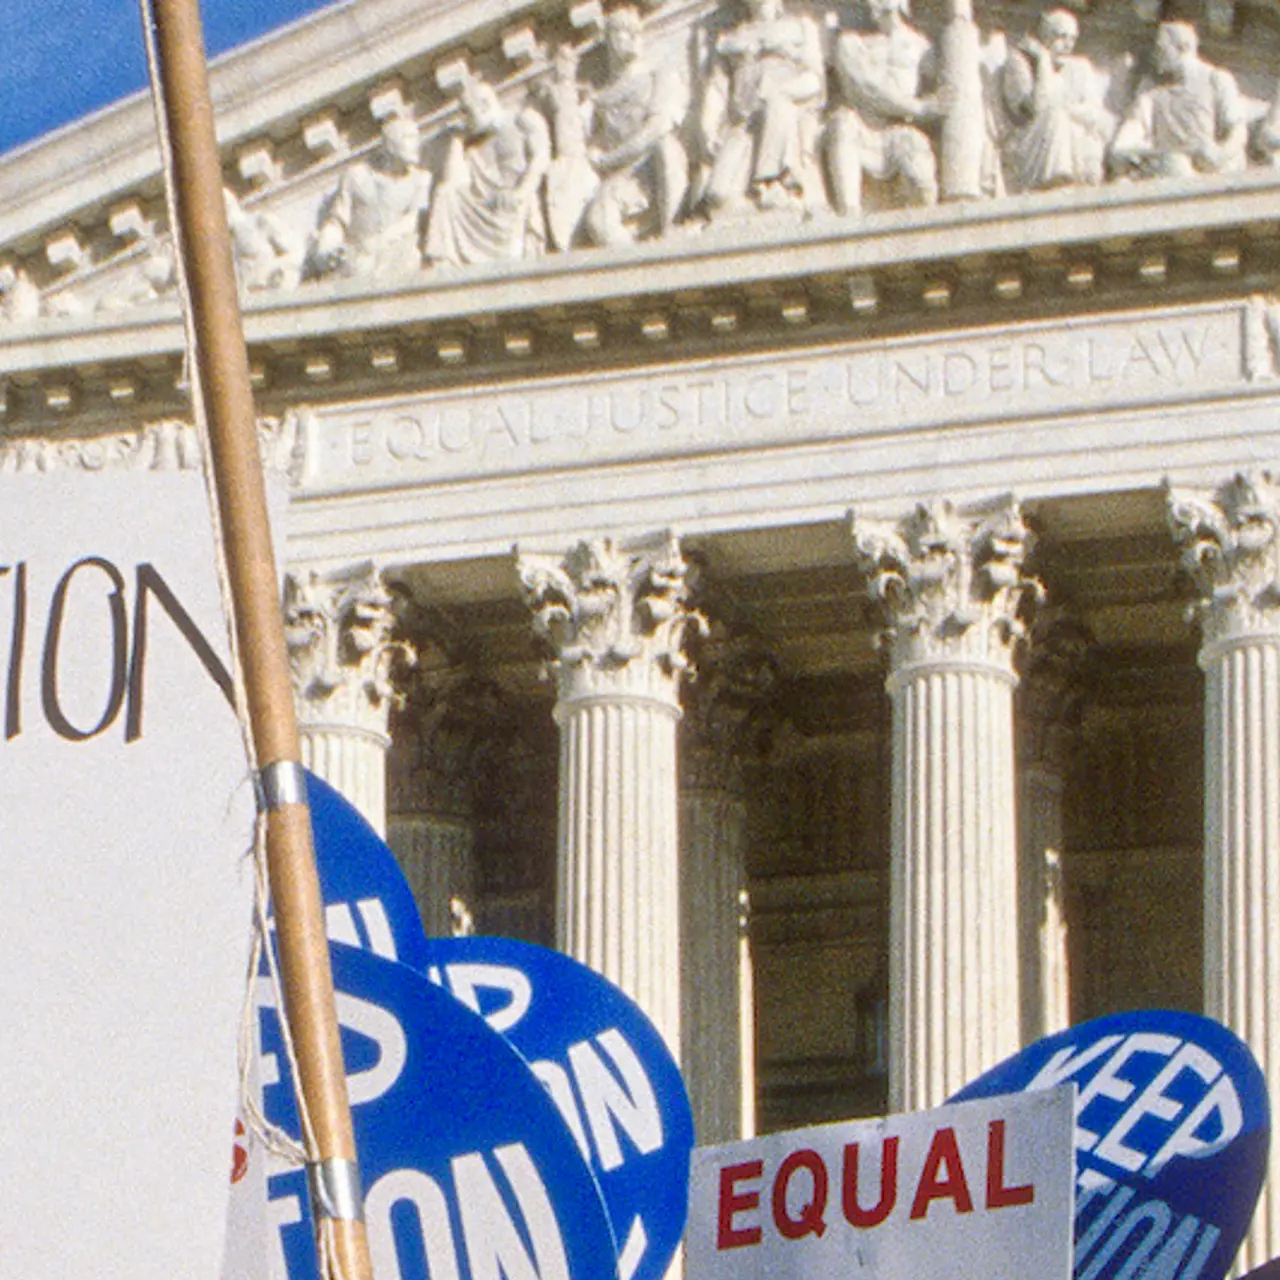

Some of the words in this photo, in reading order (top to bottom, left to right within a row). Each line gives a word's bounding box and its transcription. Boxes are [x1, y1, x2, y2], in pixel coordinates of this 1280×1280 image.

[344, 402, 551, 466] EQUAL
[568, 364, 810, 436] JUSTICE
[842, 341, 1064, 410] UNDER
[1086, 325, 1211, 384] LAW
[715, 1118, 1035, 1251] EQUAL
